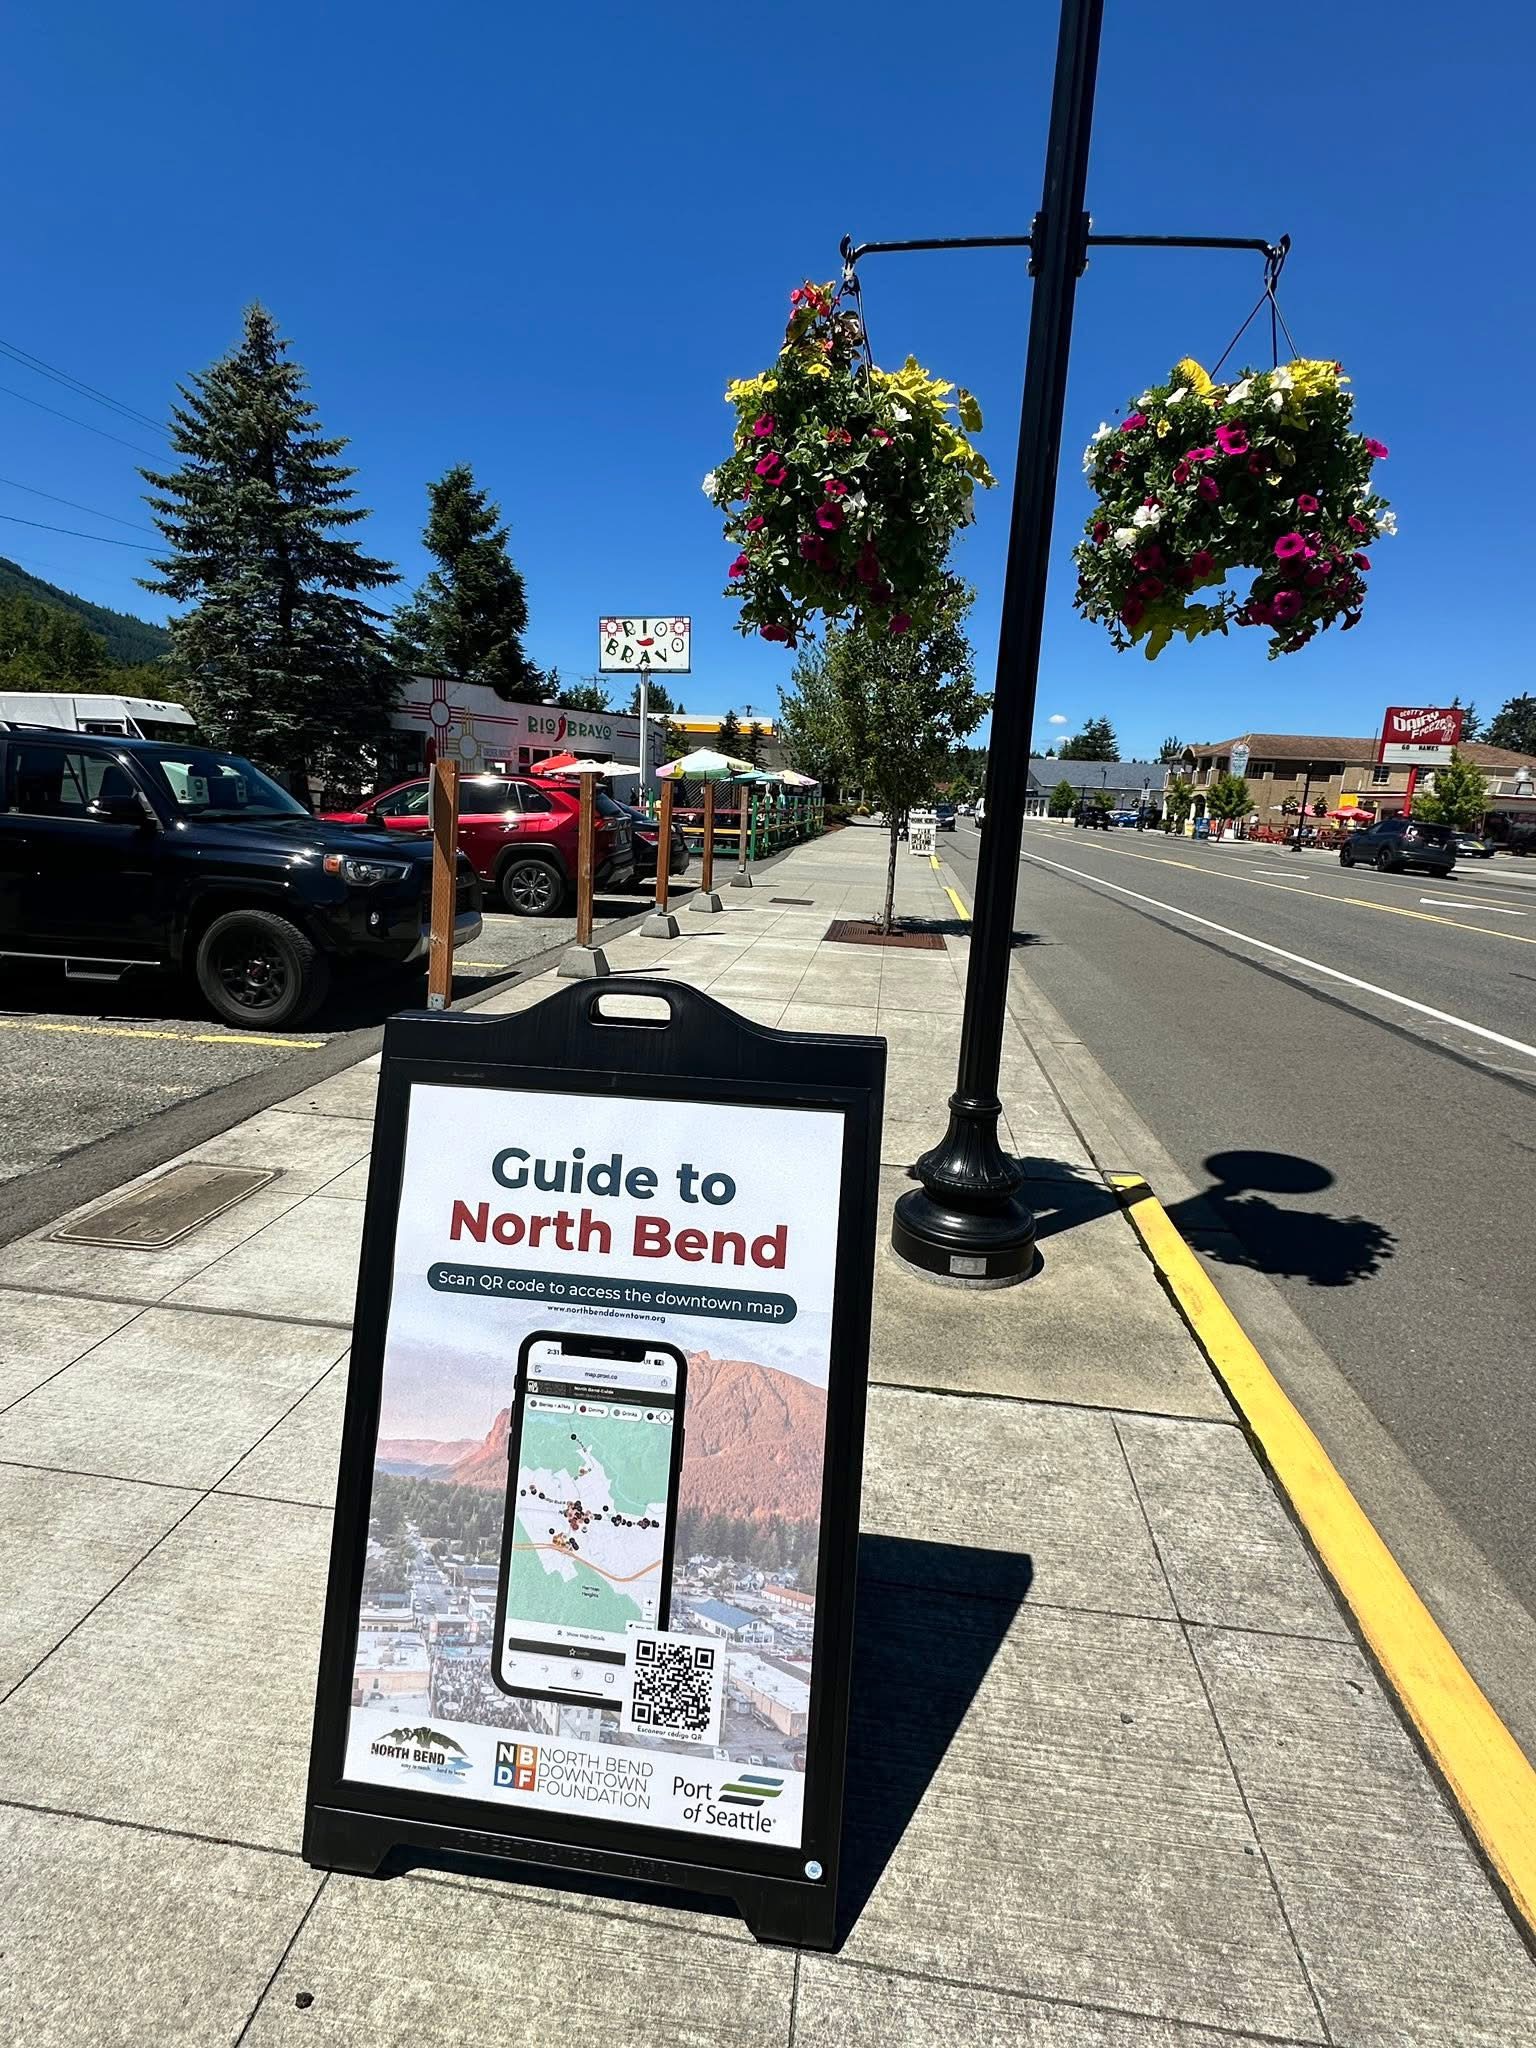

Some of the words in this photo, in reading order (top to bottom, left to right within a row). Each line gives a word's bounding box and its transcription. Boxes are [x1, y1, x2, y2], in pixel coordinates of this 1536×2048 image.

[622, 620, 667, 637] RIO
[605, 638, 684, 664] BRAVO
[528, 716, 555, 734] RIO
[567, 720, 612, 740] BRAVO
[1393, 711, 1440, 731] DAIRY
[492, 1147, 659, 1199] Guide
[676, 1163, 736, 1205] to
[450, 1200, 612, 1254] North
[633, 1215, 788, 1269] Bend
[438, 1270, 475, 1286] Scan
[479, 1274, 503, 1290] QR
[507, 1279, 545, 1293] code
[549, 1281, 565, 1294] to
[569, 1285, 621, 1300] access
[625, 1288, 651, 1303] the
[656, 1291, 742, 1311] downtown
[747, 1302, 784, 1317] map
[547, 1305, 666, 1323] www.northbenddowntown.org
[691, 1733, 702, 1741] QR
[371, 1743, 409, 1759] NORTH
[413, 1749, 445, 1765] BEND
[540, 1748, 600, 1769] NORTH
[606, 1757, 653, 1777] BEND
[538, 1763, 648, 1792] DOWNTOWN
[673, 1776, 712, 1800] Port
[537, 1779, 650, 1810] FOUNDATION
[683, 1803, 702, 1823] of
[706, 1804, 773, 1833] Seattle
